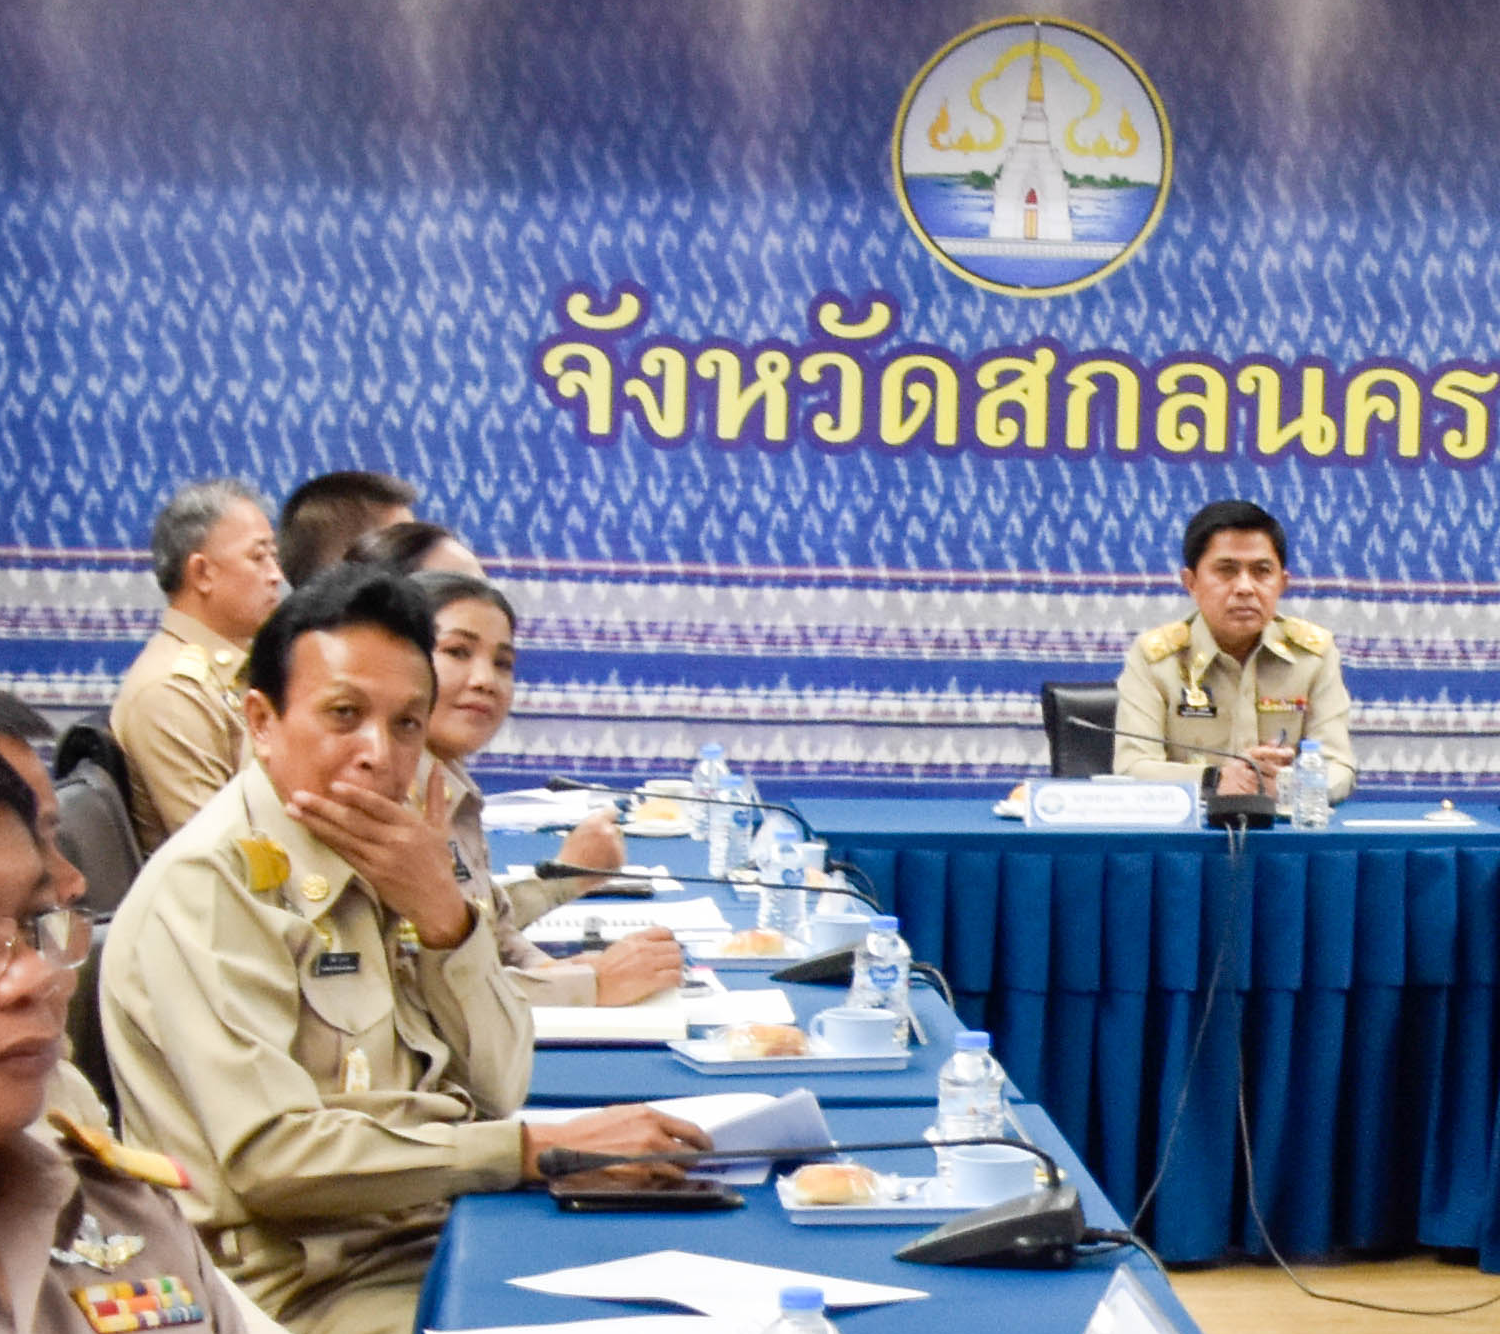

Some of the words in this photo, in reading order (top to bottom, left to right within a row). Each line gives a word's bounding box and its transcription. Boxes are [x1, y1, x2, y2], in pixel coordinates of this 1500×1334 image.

[542, 292, 1500, 460] จังหวัดสกลนคร
